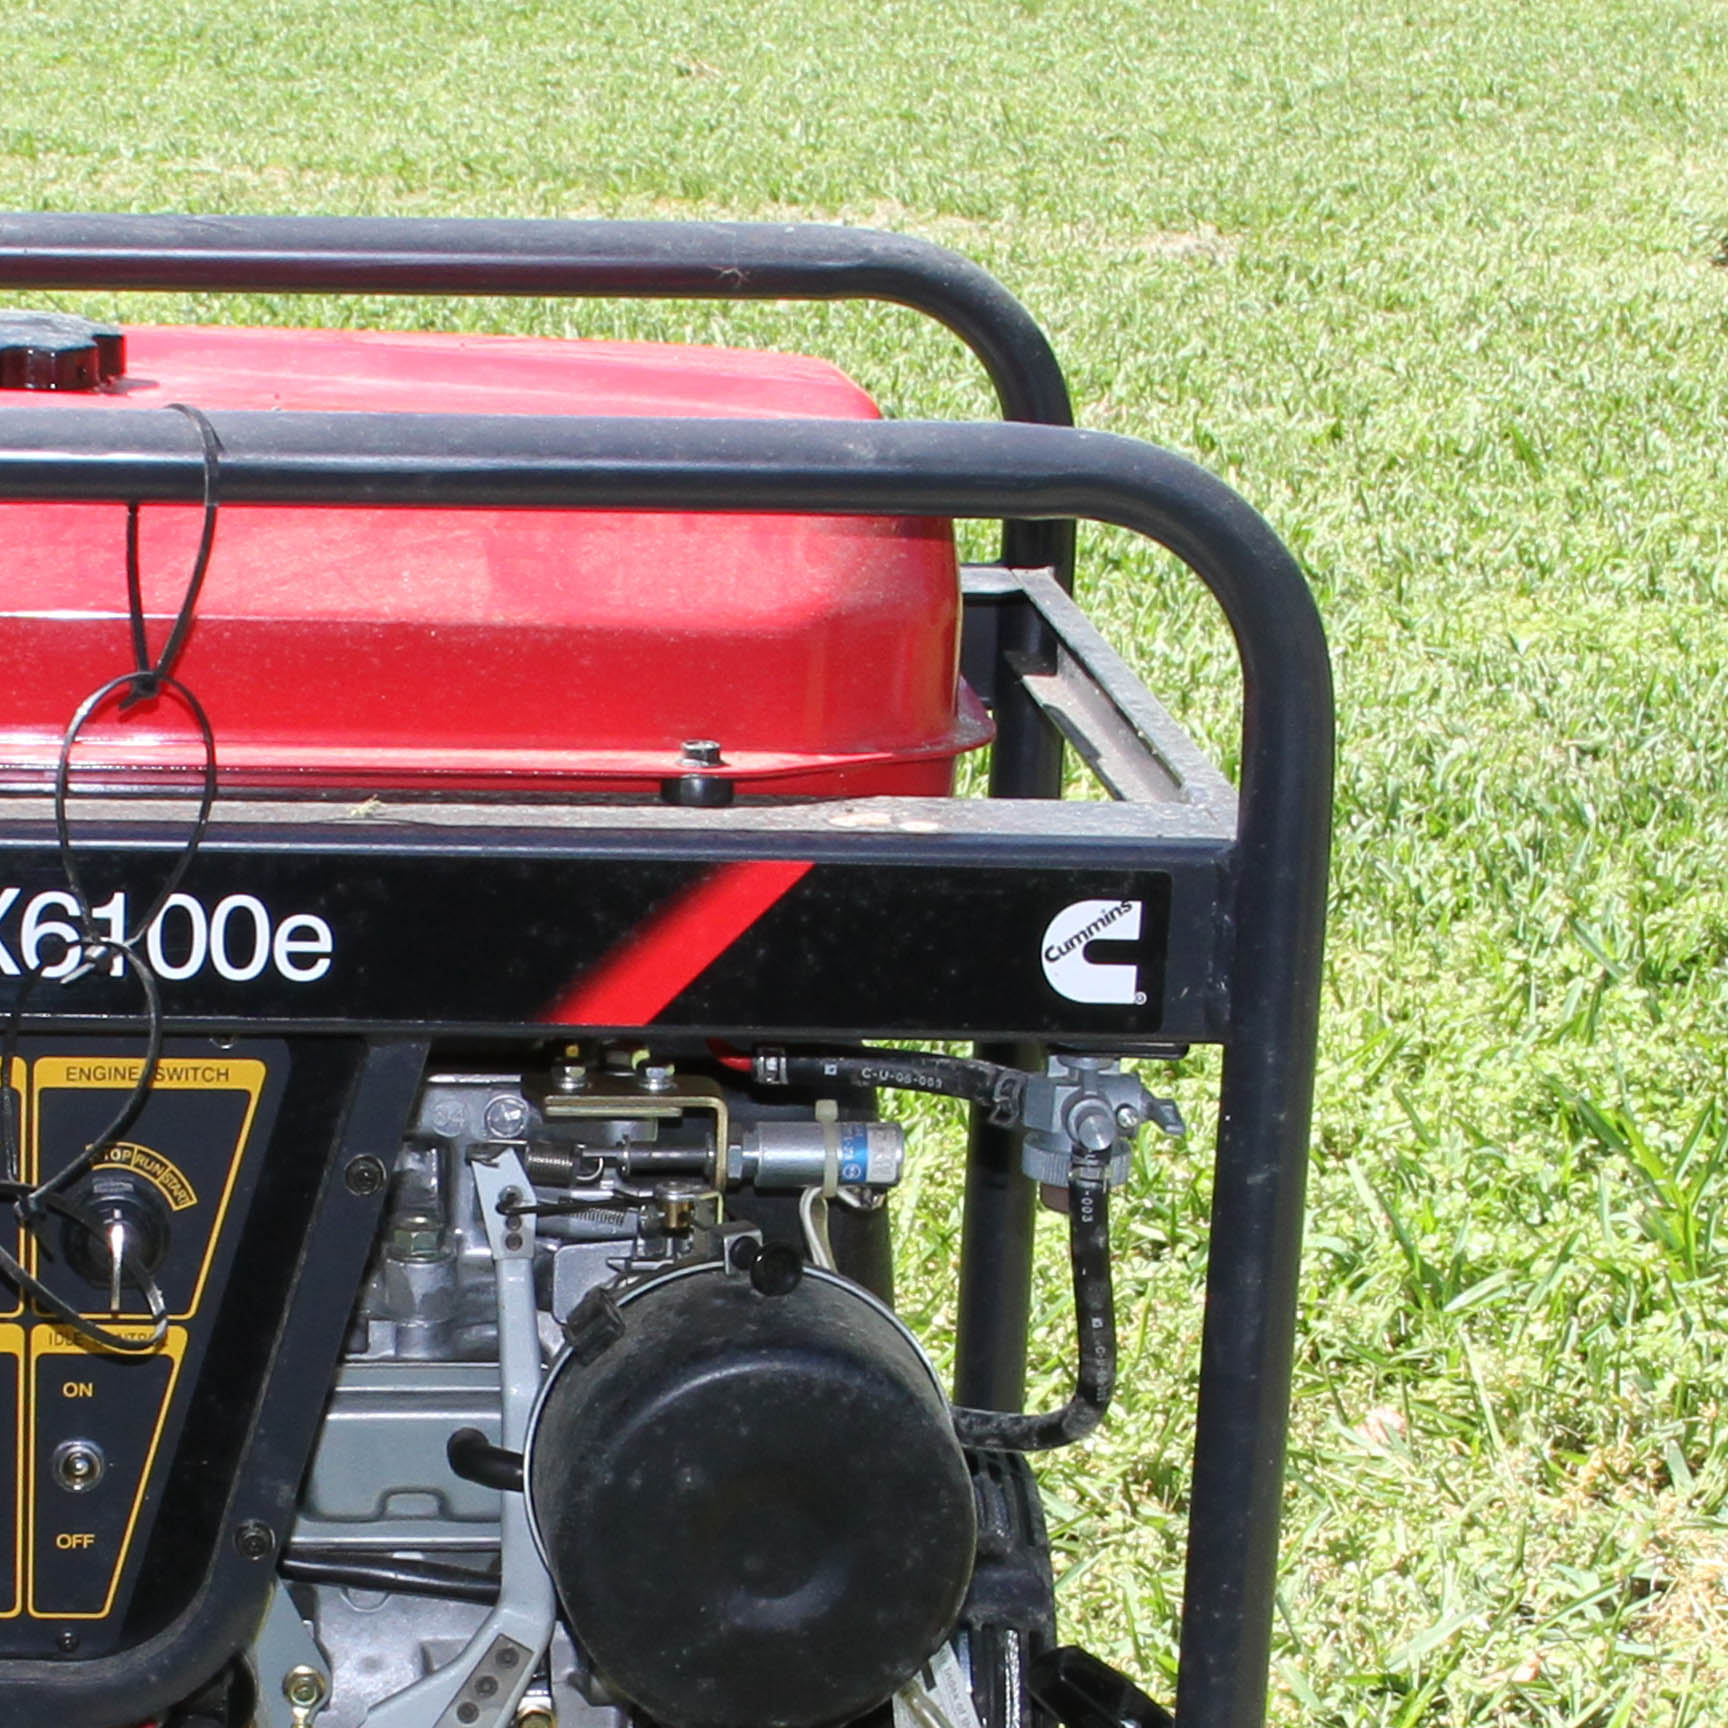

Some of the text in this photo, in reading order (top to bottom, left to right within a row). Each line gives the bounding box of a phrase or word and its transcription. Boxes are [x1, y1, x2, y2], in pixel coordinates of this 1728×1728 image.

[1043, 899, 1134, 964] Cummins
[65, 1066, 230, 1084] ENGINE SWITCH
[136, 1153, 165, 1177] RUN
[160, 1172, 191, 1206] START
[62, 1381, 94, 1399] ON
[55, 1532, 95, 1550] OFF
